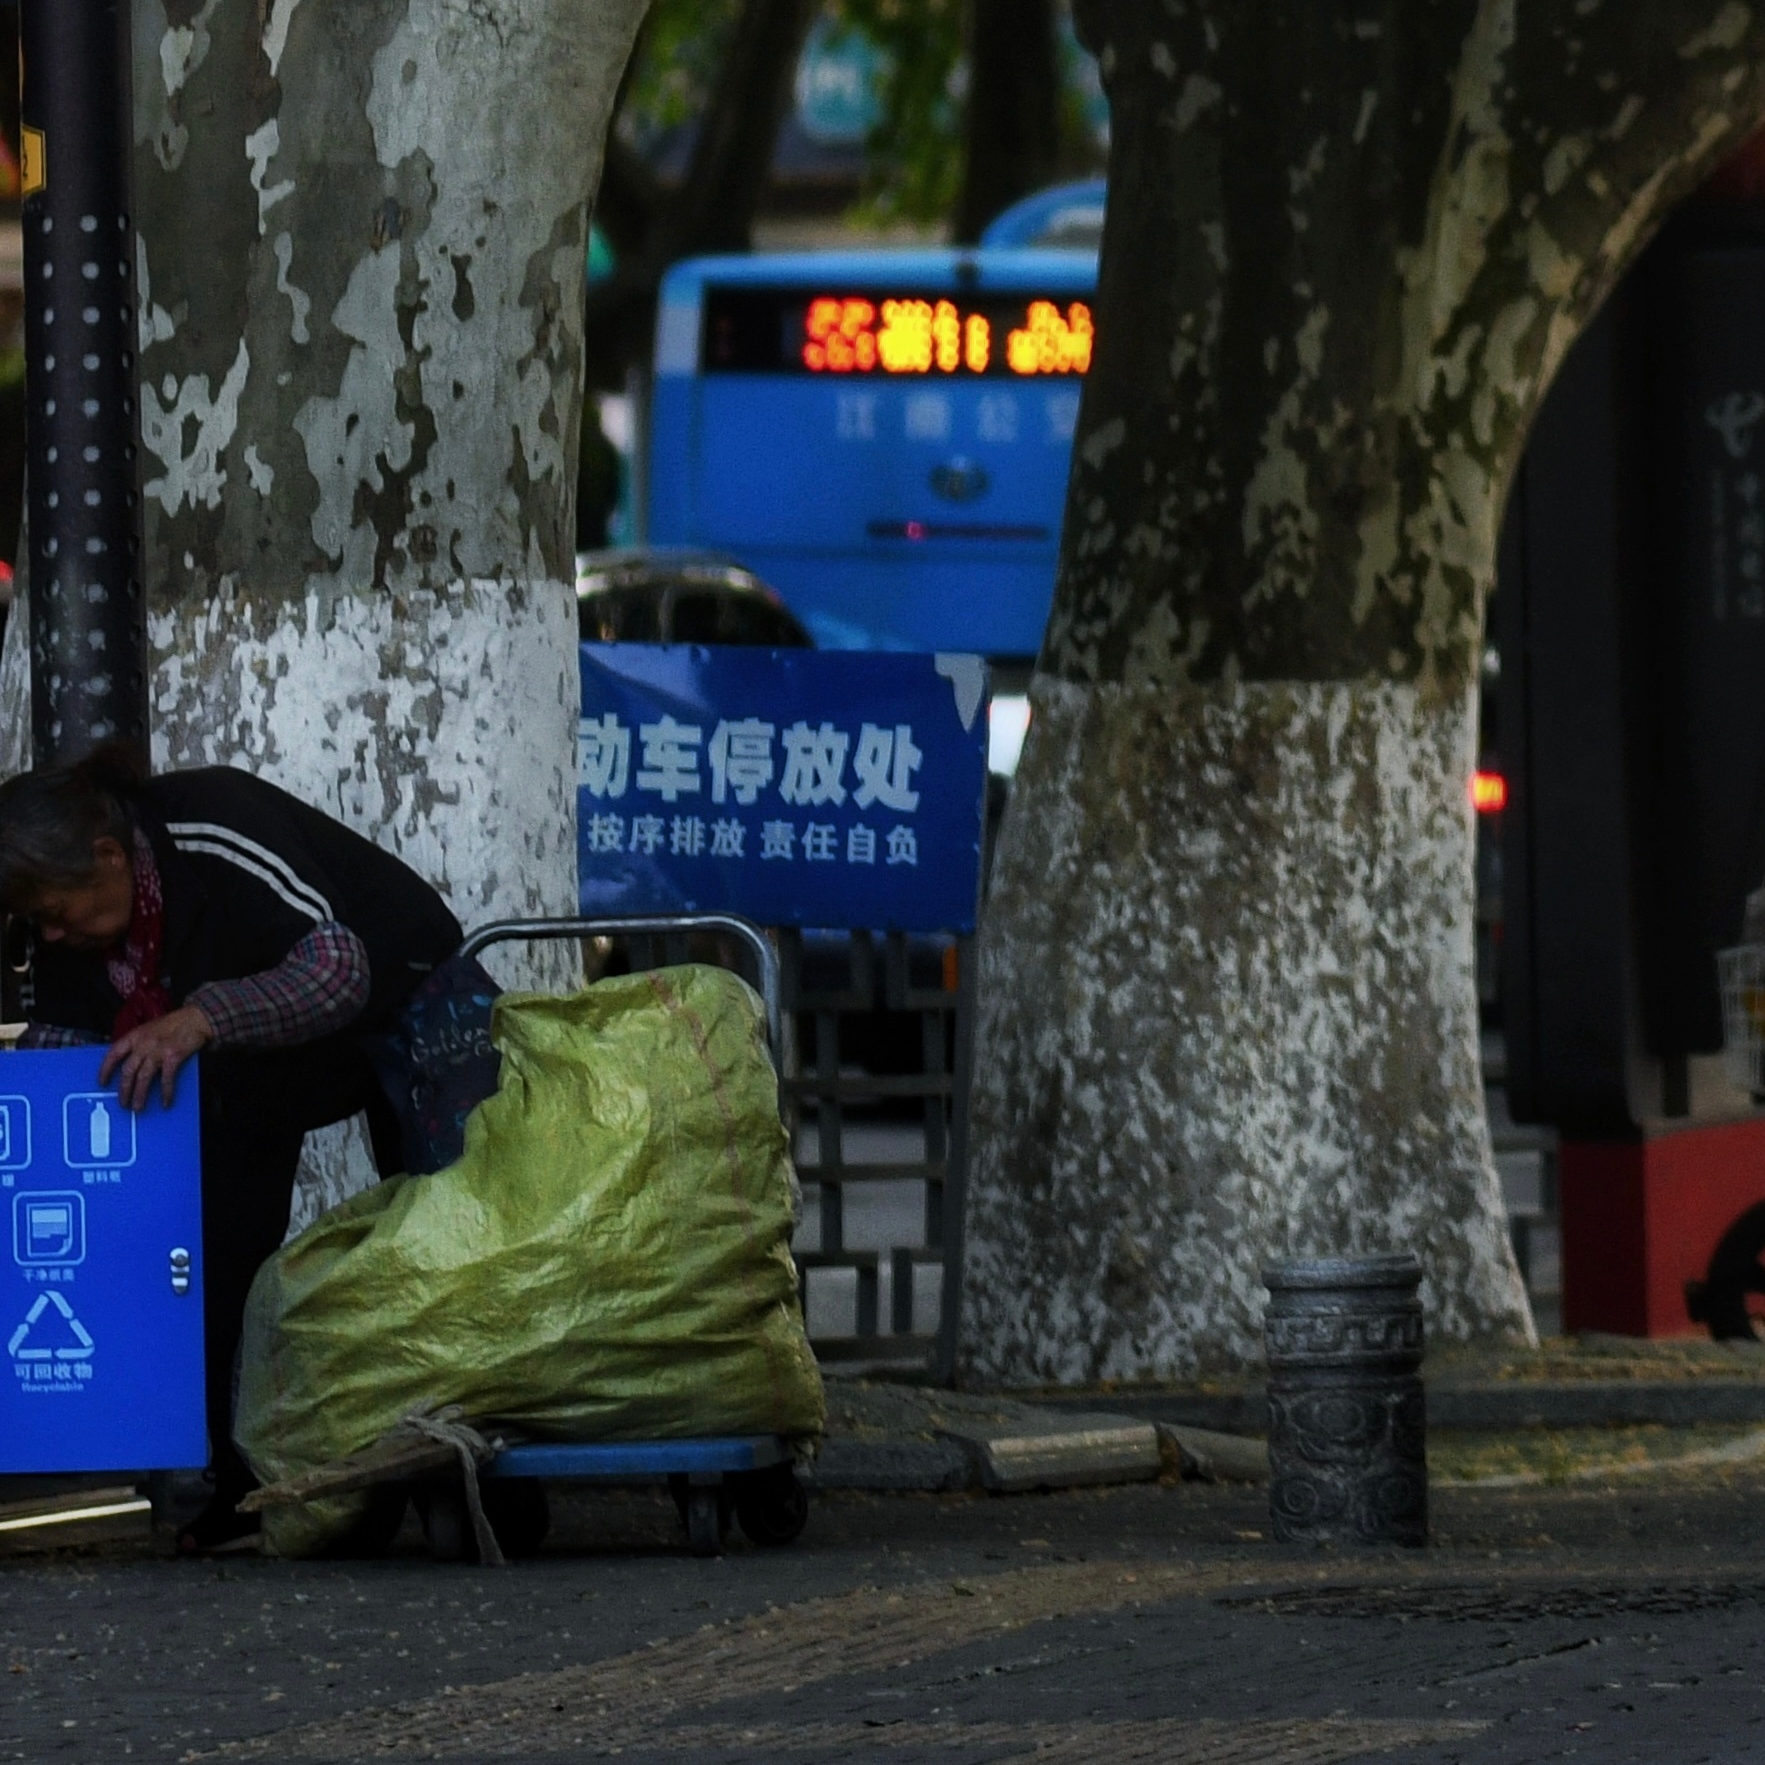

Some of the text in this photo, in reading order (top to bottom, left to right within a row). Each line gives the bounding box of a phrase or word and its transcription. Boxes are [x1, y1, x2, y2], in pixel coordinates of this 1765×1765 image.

[579, 712, 923, 813] 动车停放处
[586, 813, 919, 867] 按序排放 责任自负
[14, 1362, 93, 1381] 可回收物
